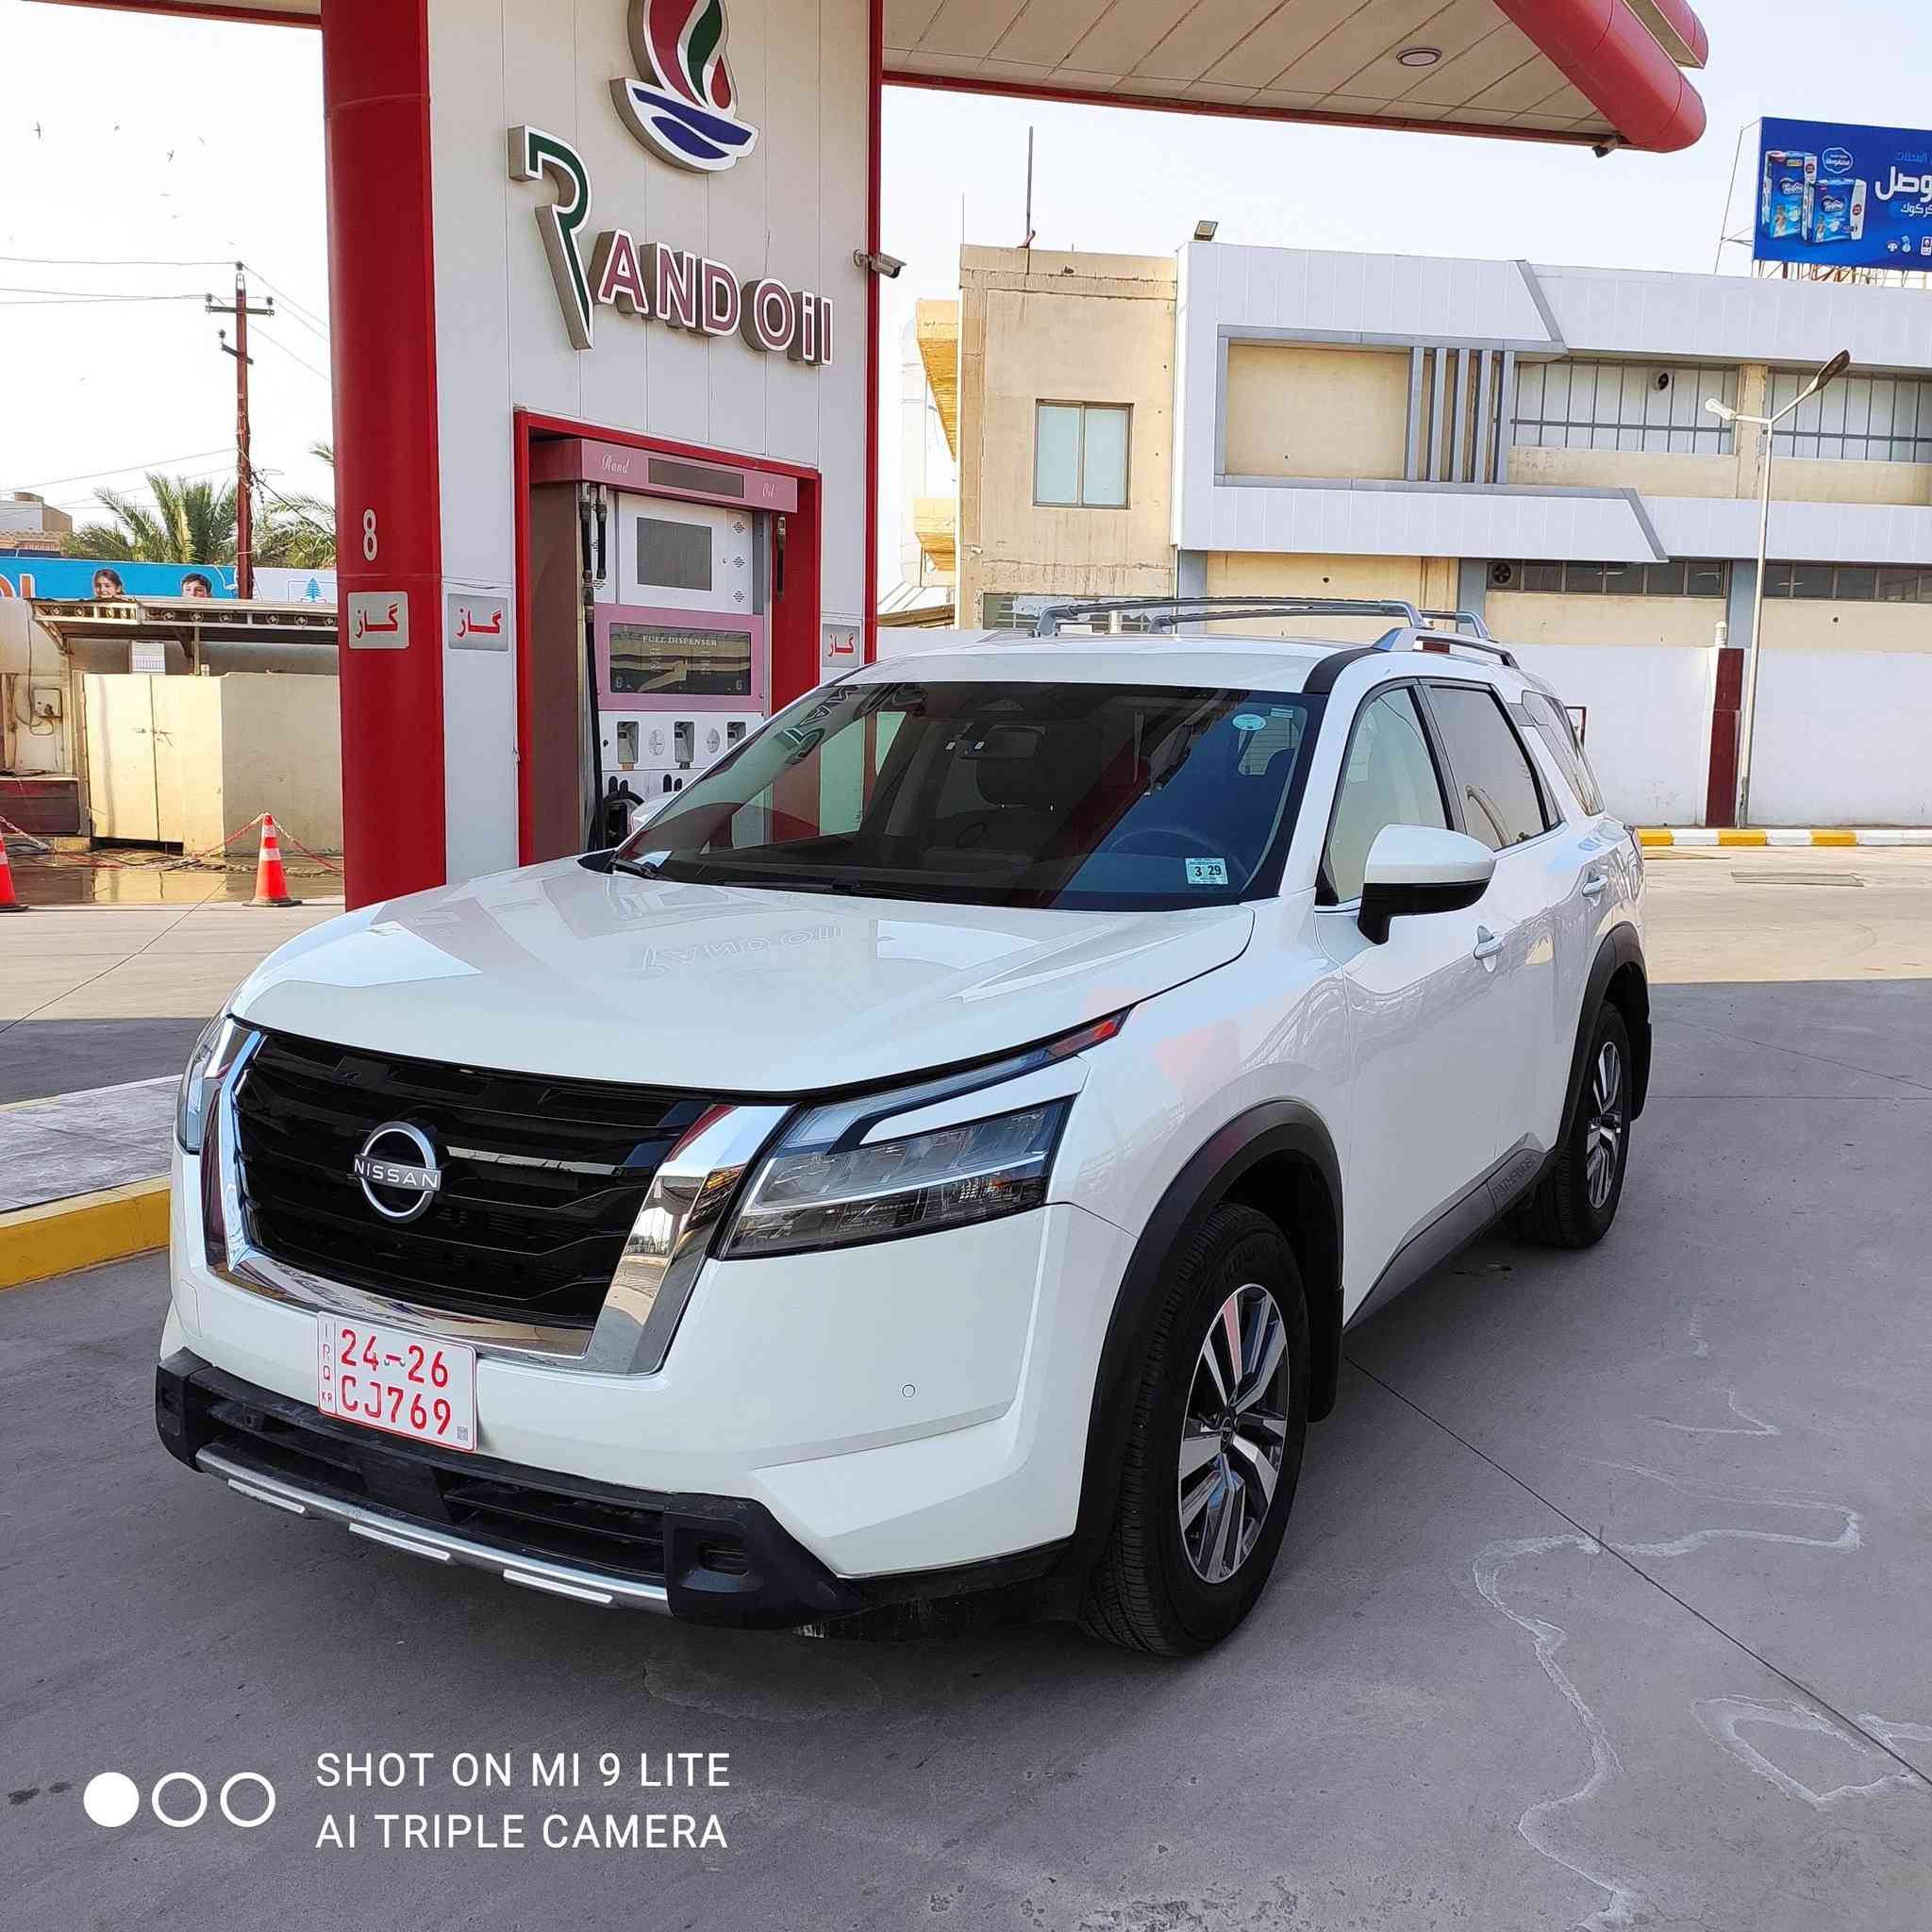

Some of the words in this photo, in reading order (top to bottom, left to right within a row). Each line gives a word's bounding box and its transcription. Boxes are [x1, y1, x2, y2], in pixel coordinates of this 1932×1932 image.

[601, 453, 630, 474] Rand
[362, 508, 378, 561] 8
[642, 634, 666, 644] FUEL
[667, 635, 717, 647] DISPENSER
[1194, 866, 1203, 876] 3
[1208, 865, 1222, 875] 29
[354, 1158, 438, 1189] NISSAN
[341, 1328, 449, 1388] 24-26
[341, 1374, 451, 1436] CJ769
